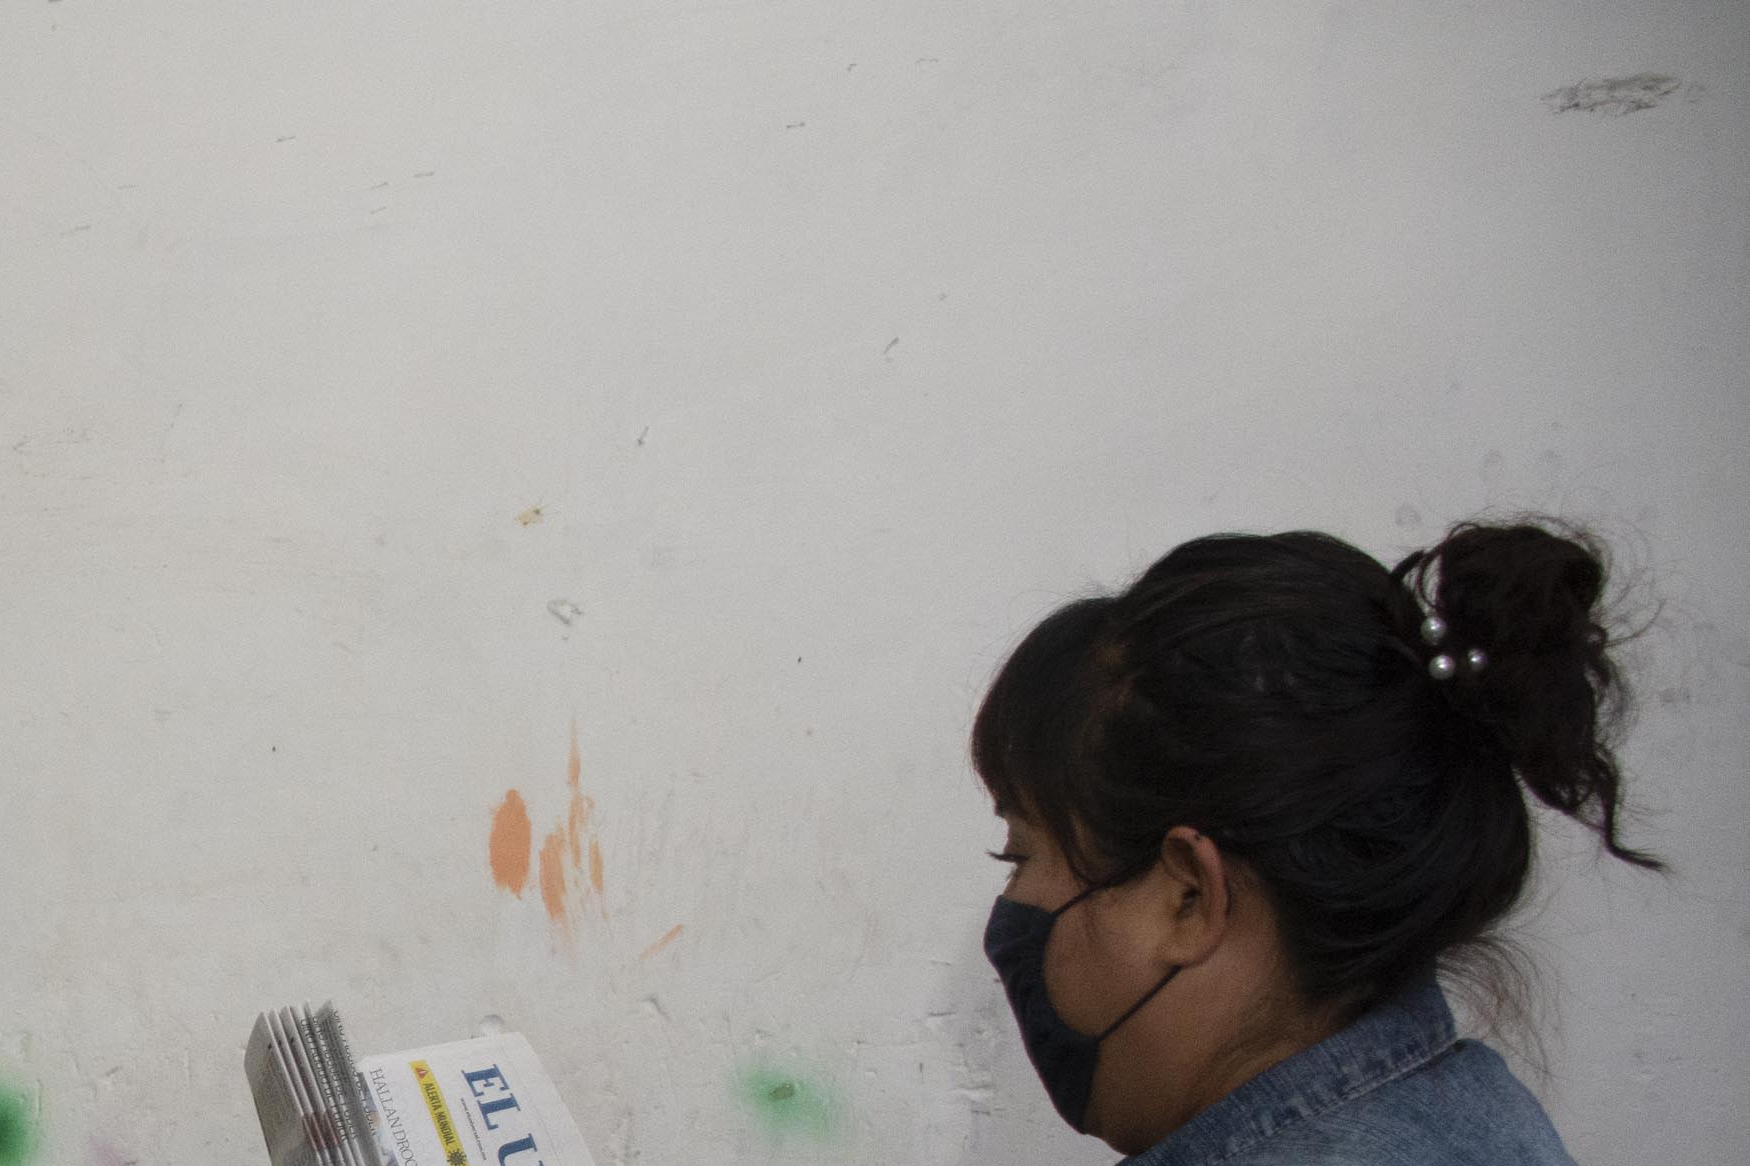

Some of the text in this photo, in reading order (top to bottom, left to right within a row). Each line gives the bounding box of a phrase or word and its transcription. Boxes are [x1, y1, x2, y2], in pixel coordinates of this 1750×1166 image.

[368, 1069, 402, 1132] HALLAN
[423, 1082, 455, 1146] ALERTA MUNDIAL
[460, 1063, 521, 1131] EL
